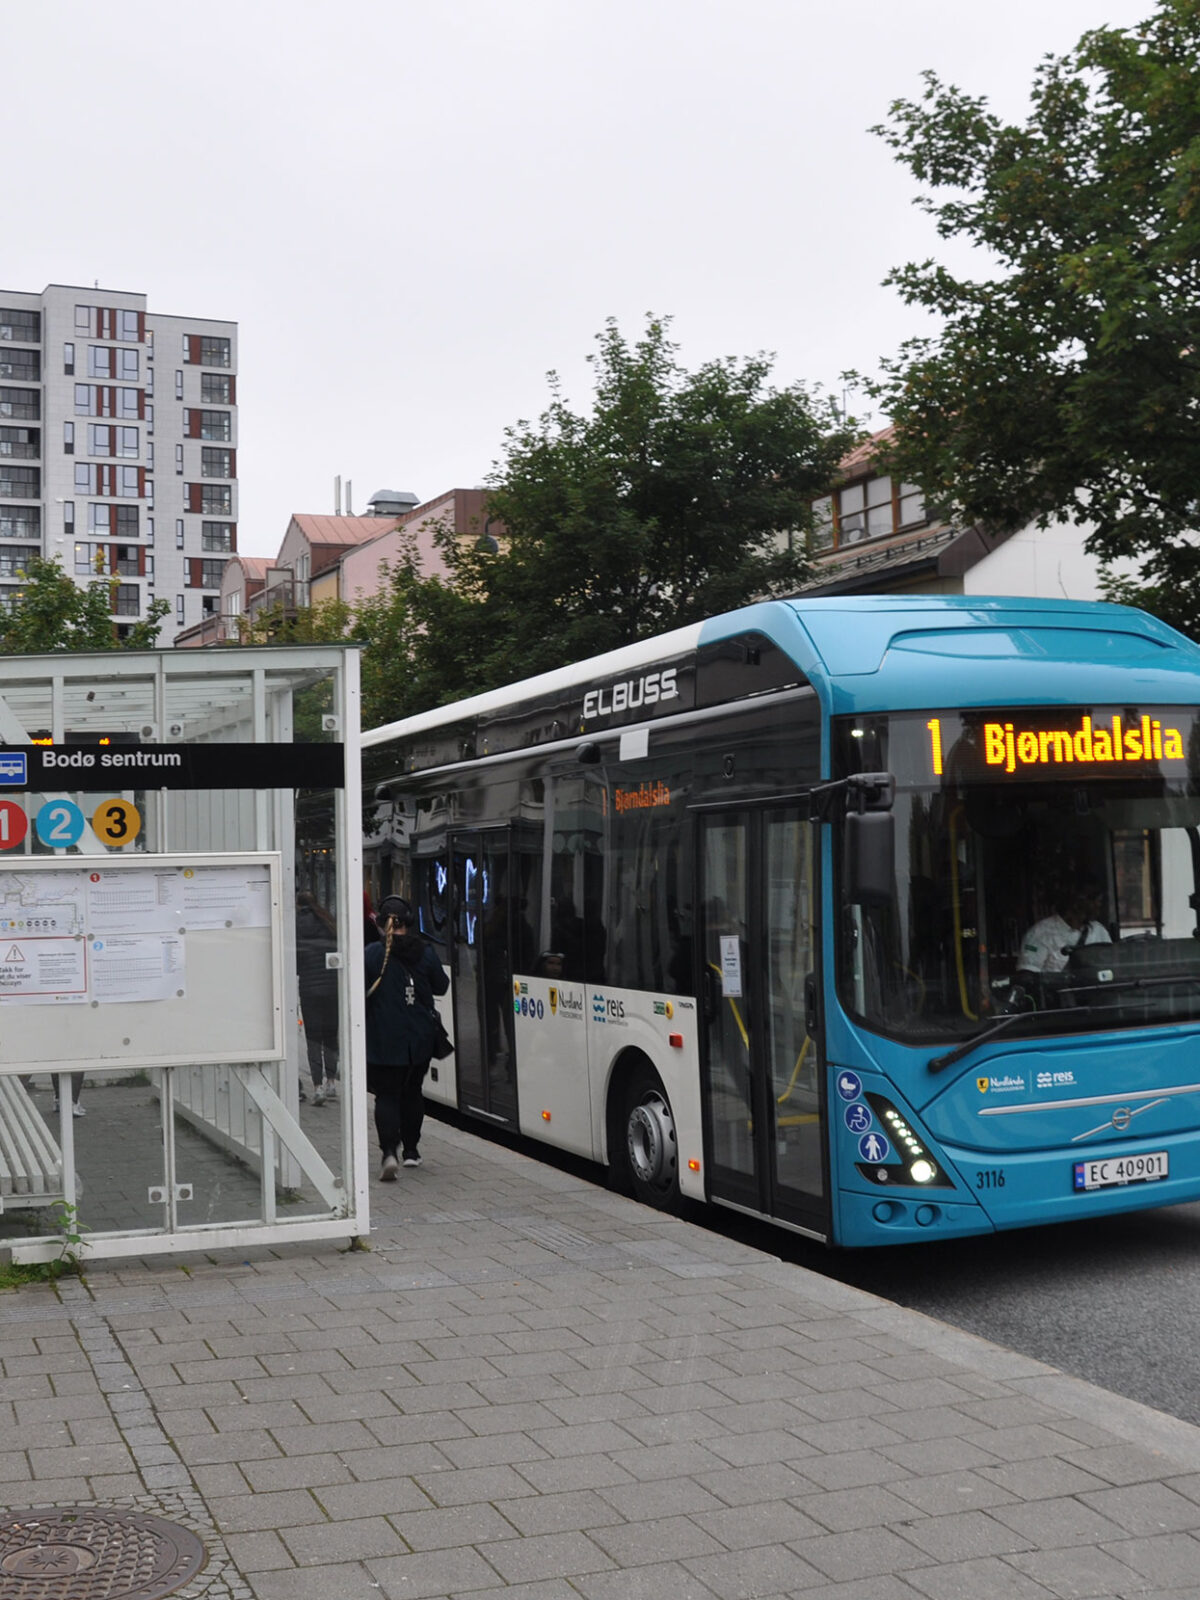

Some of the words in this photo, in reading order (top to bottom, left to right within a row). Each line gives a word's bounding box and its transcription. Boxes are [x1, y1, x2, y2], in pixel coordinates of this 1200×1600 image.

[583, 668, 678, 719] ELBUSS
[927, 718, 943, 775] 1
[984, 715, 1185, 773] Bjørndalslia
[42, 751, 96, 768] Bodø
[100, 751, 182, 767] sentrum
[0, 809, 9, 841] 1
[49, 807, 72, 840] 2
[106, 806, 128, 839] 3
[606, 999, 625, 1018] reis
[1053, 1071, 1074, 1082] reis
[976, 1169, 1005, 1190] 3116
[1090, 1163, 1109, 1182] EC
[1116, 1157, 1162, 1178] 40901
